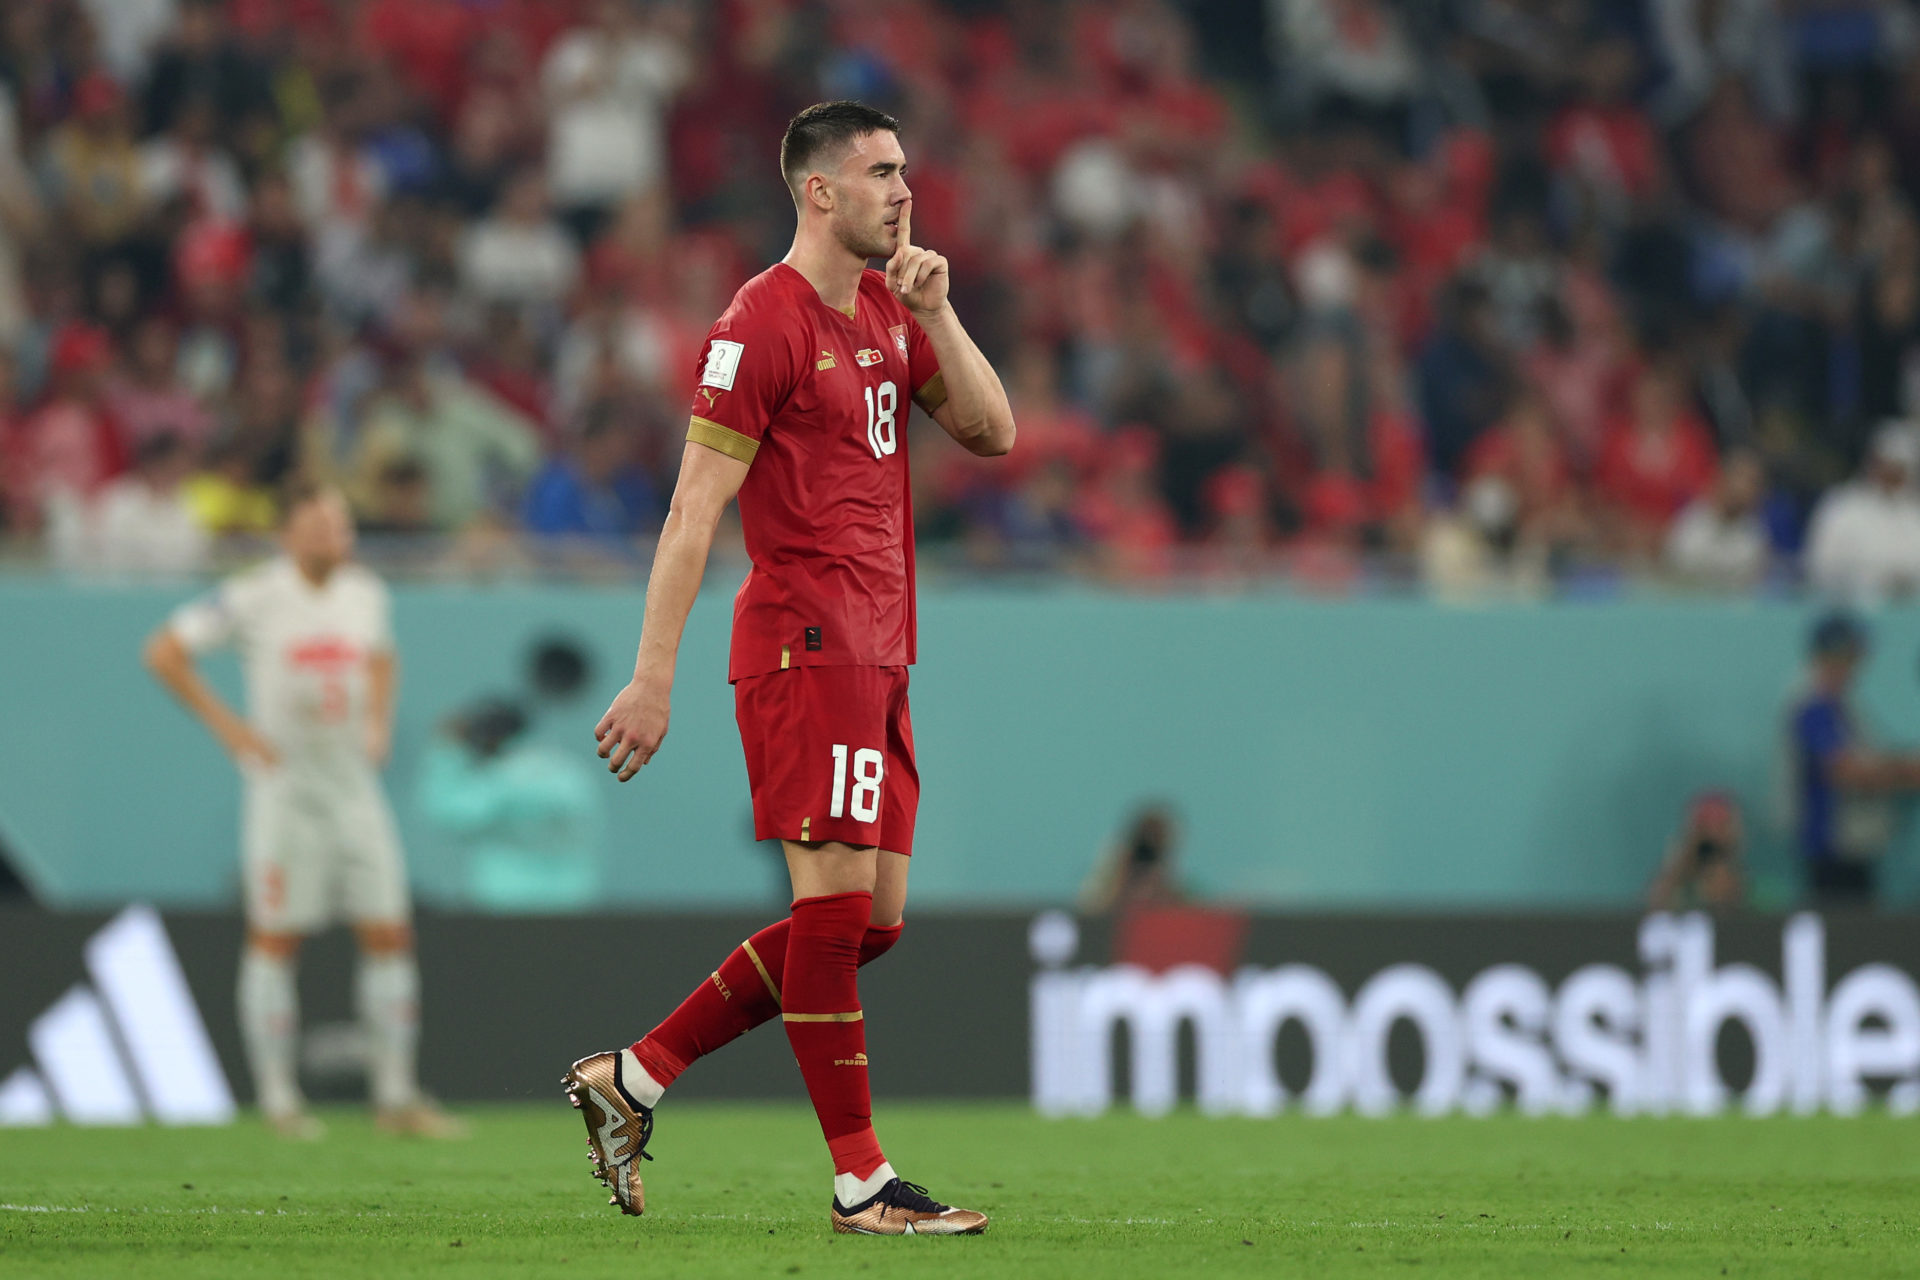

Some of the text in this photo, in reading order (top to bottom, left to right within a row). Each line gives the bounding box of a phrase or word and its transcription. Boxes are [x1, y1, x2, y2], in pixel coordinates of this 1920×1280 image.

[864, 380, 897, 459] 18
[829, 743, 885, 824] 18
[1028, 911, 1920, 1118] impossible
